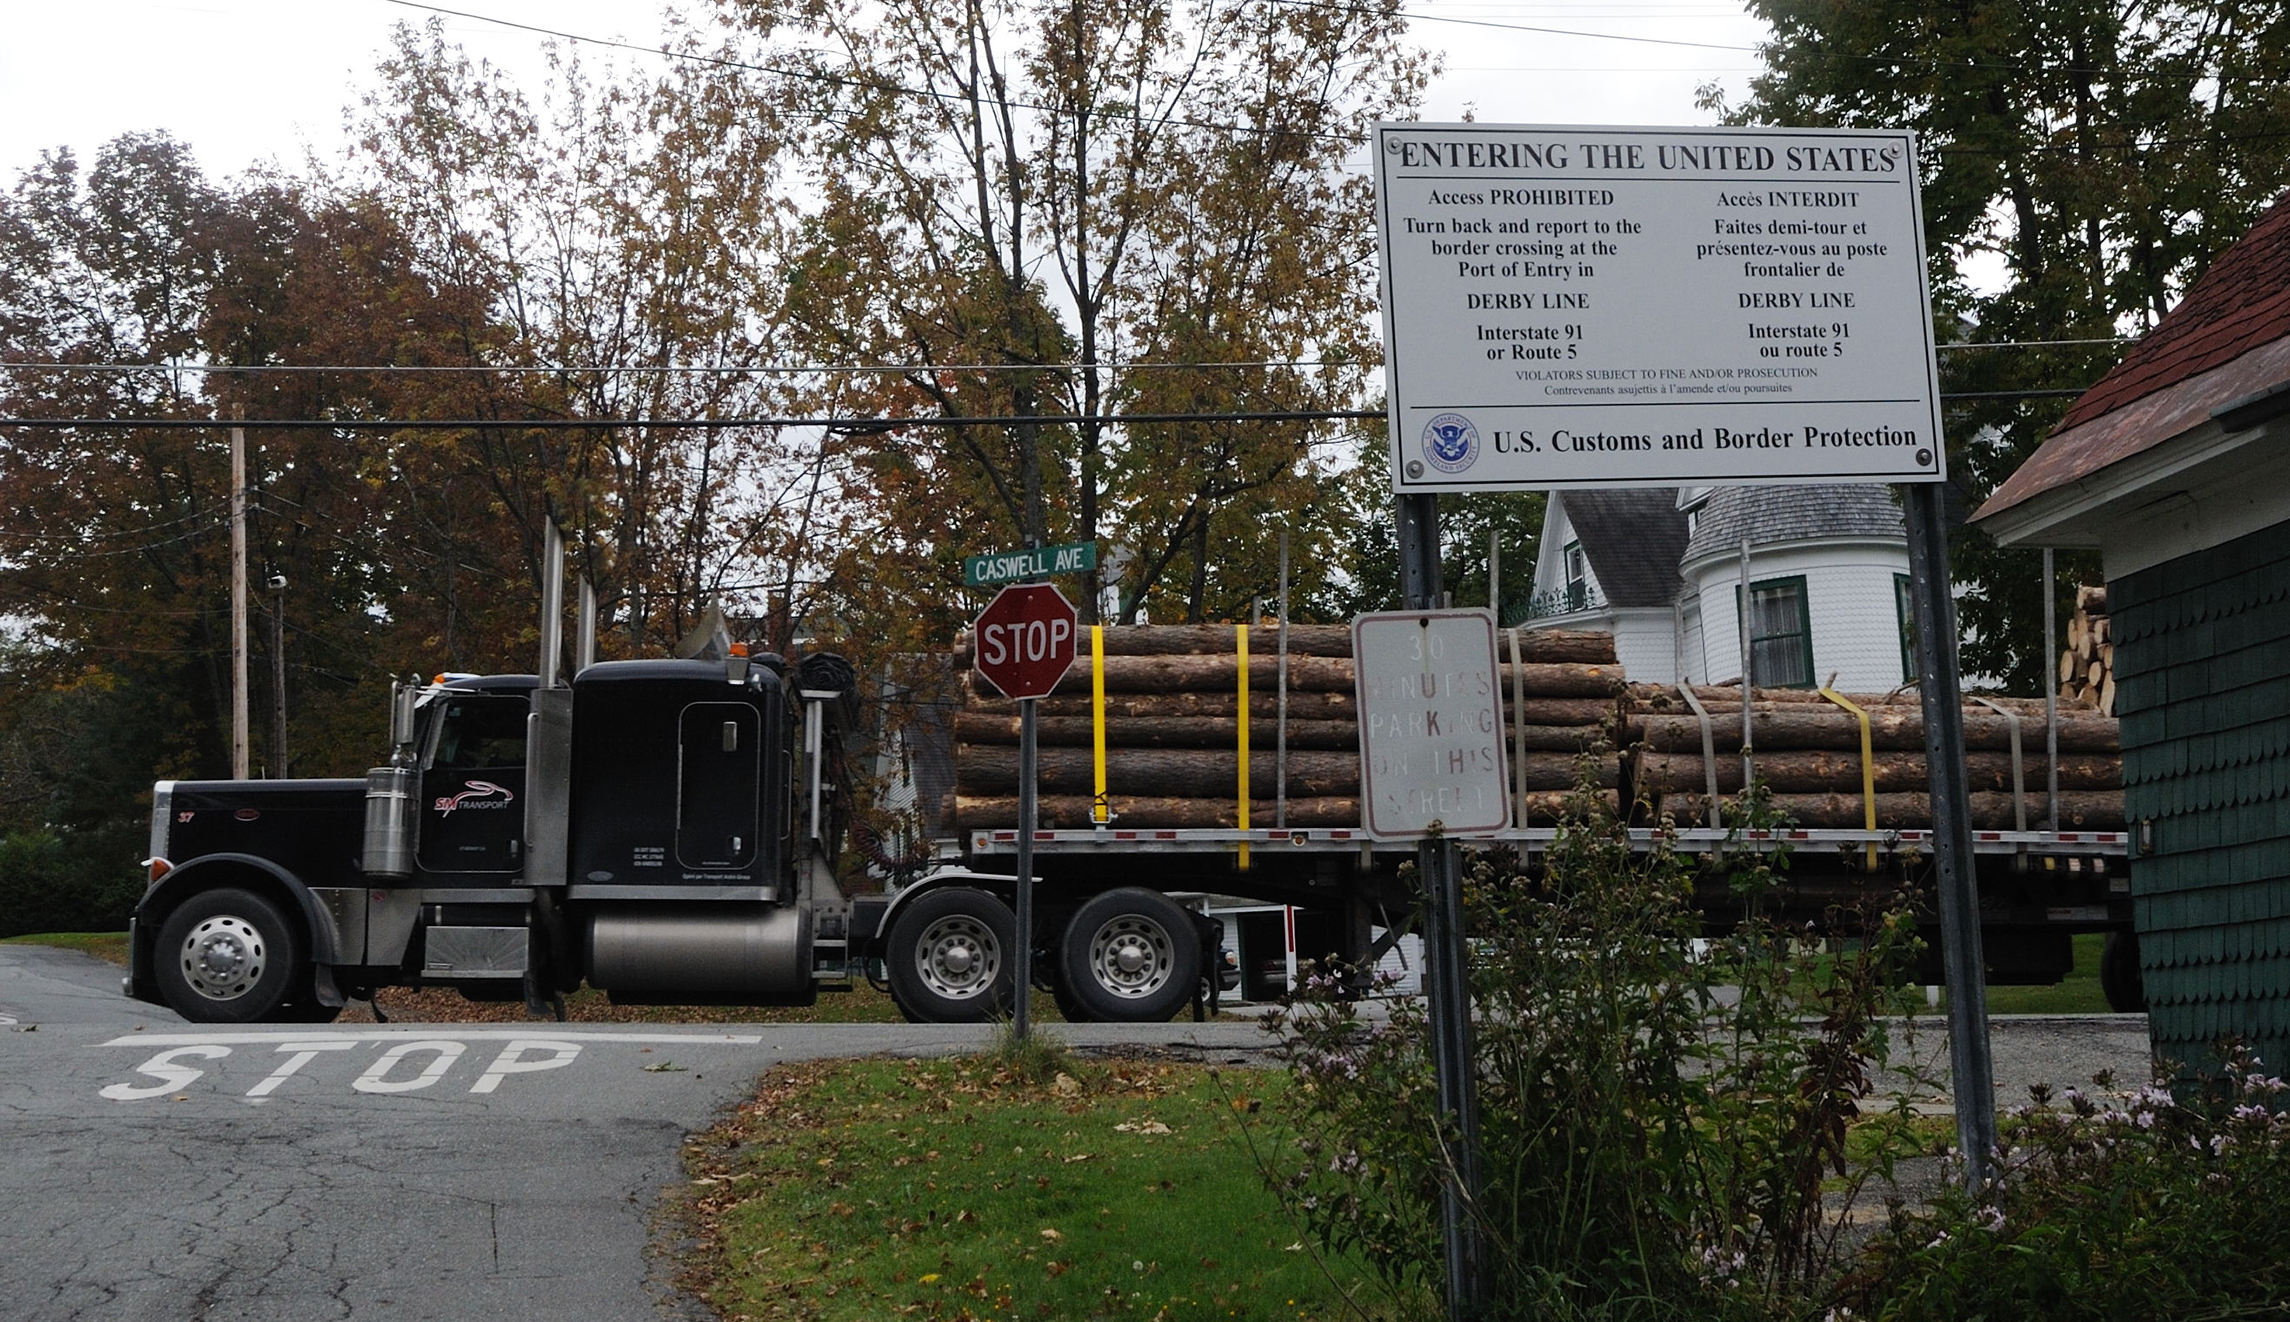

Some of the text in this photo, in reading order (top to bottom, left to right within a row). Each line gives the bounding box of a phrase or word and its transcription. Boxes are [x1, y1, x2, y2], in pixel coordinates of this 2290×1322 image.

[1400, 142, 1896, 172] ENTERING THE UNITED STATES
[1429, 190, 1613, 205] Access PROHIBITED
[1718, 192, 1859, 207] Accès INTERDIT
[1404, 218, 1641, 238] Turn back and report to the
[1715, 219, 1866, 234] Faites demi-tour et
[1432, 240, 1617, 259] border crossing at the
[1697, 241, 1887, 260] présentez-vous au poste
[1459, 262, 1593, 281] Port of Entry in
[1745, 262, 1844, 276] frontalier de
[1468, 294, 1589, 309] DERBY LINE
[1739, 293, 1855, 308] DERBY LINE
[1478, 325, 1582, 340] Interstate 91
[1749, 323, 1848, 338] Interstate 91
[1487, 344, 1576, 360] or Route 5
[1760, 342, 1842, 357] ou route 5
[1516, 368, 1817, 380] VIOLATORS SUBJECT TO FINE AND/OR PROSECUTION
[1545, 383, 1792, 396] Contrevenants asujettis à l'amende et/ou poursuites
[1494, 425, 1916, 453] U.S. Customs and Border Protection
[976, 548, 1083, 581] CASWELL AVE
[984, 618, 1070, 665] STOP
[1410, 635, 1443, 660] 30
[458, 801, 509, 809] TRANSPORT
[177, 811, 195, 823] 37
[99, 1041, 583, 1100] STOP
